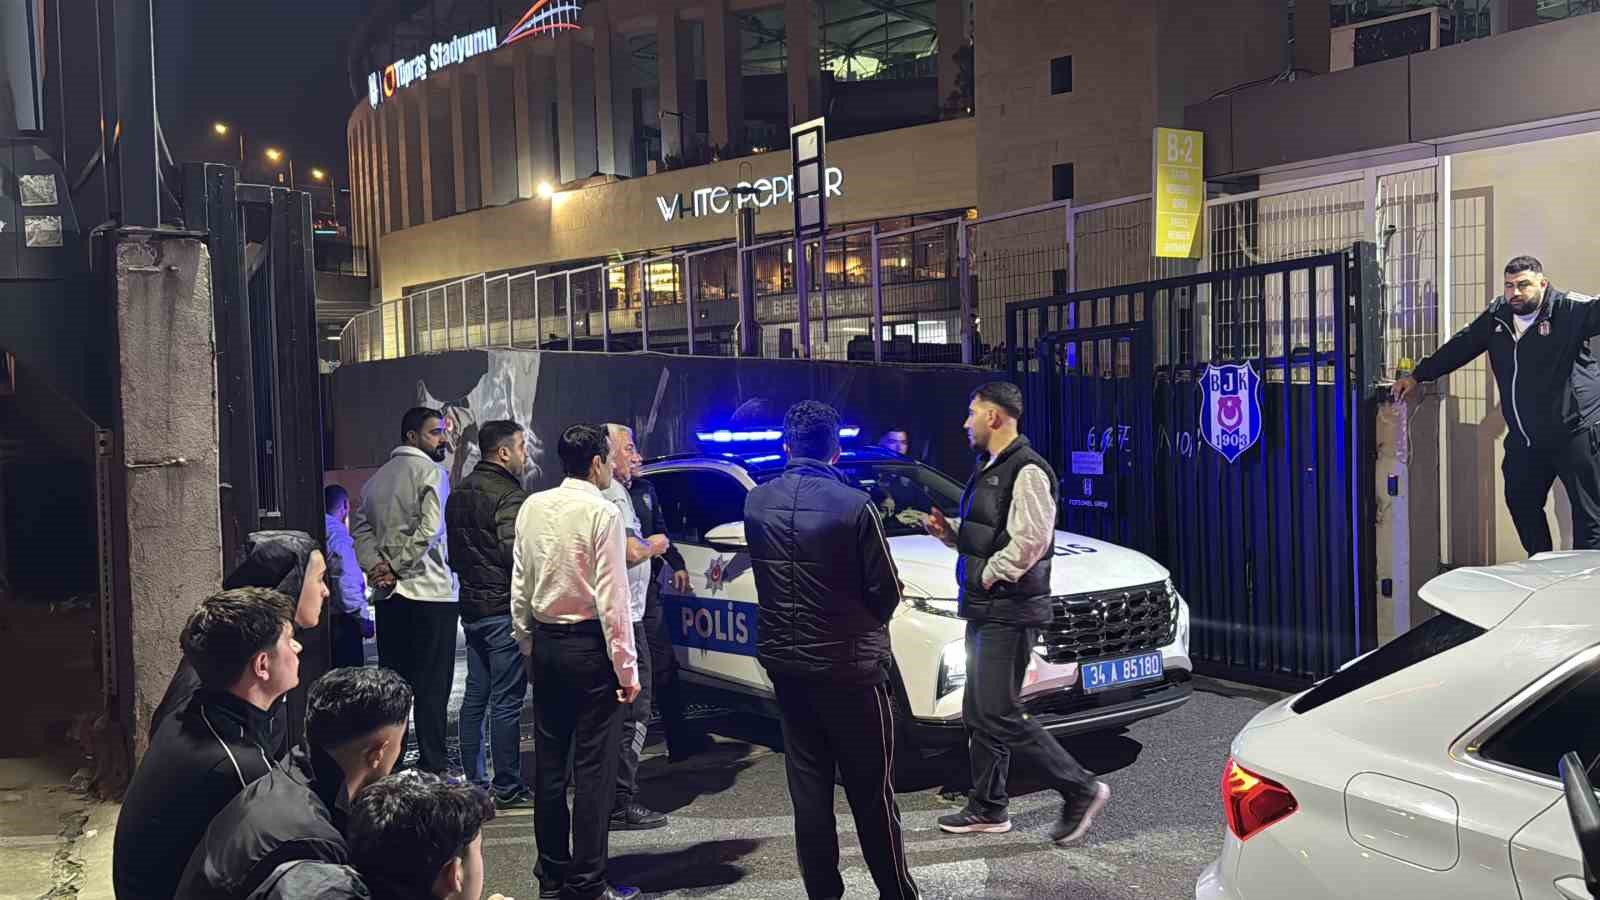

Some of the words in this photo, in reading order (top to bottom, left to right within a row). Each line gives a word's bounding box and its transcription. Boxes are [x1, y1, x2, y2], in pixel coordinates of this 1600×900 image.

[394, 53, 428, 89] Tüpraş
[429, 26, 498, 71] Stadyumu
[656, 186, 730, 222] WHITE
[736, 167, 842, 209] PEPR
[1211, 372, 1248, 392] BJK
[1215, 433, 1248, 447] 1903
[681, 601, 749, 644] POLİS
[1090, 664, 1106, 685] 34
[1111, 662, 1118, 682] A
[1123, 655, 1159, 679] 85180
